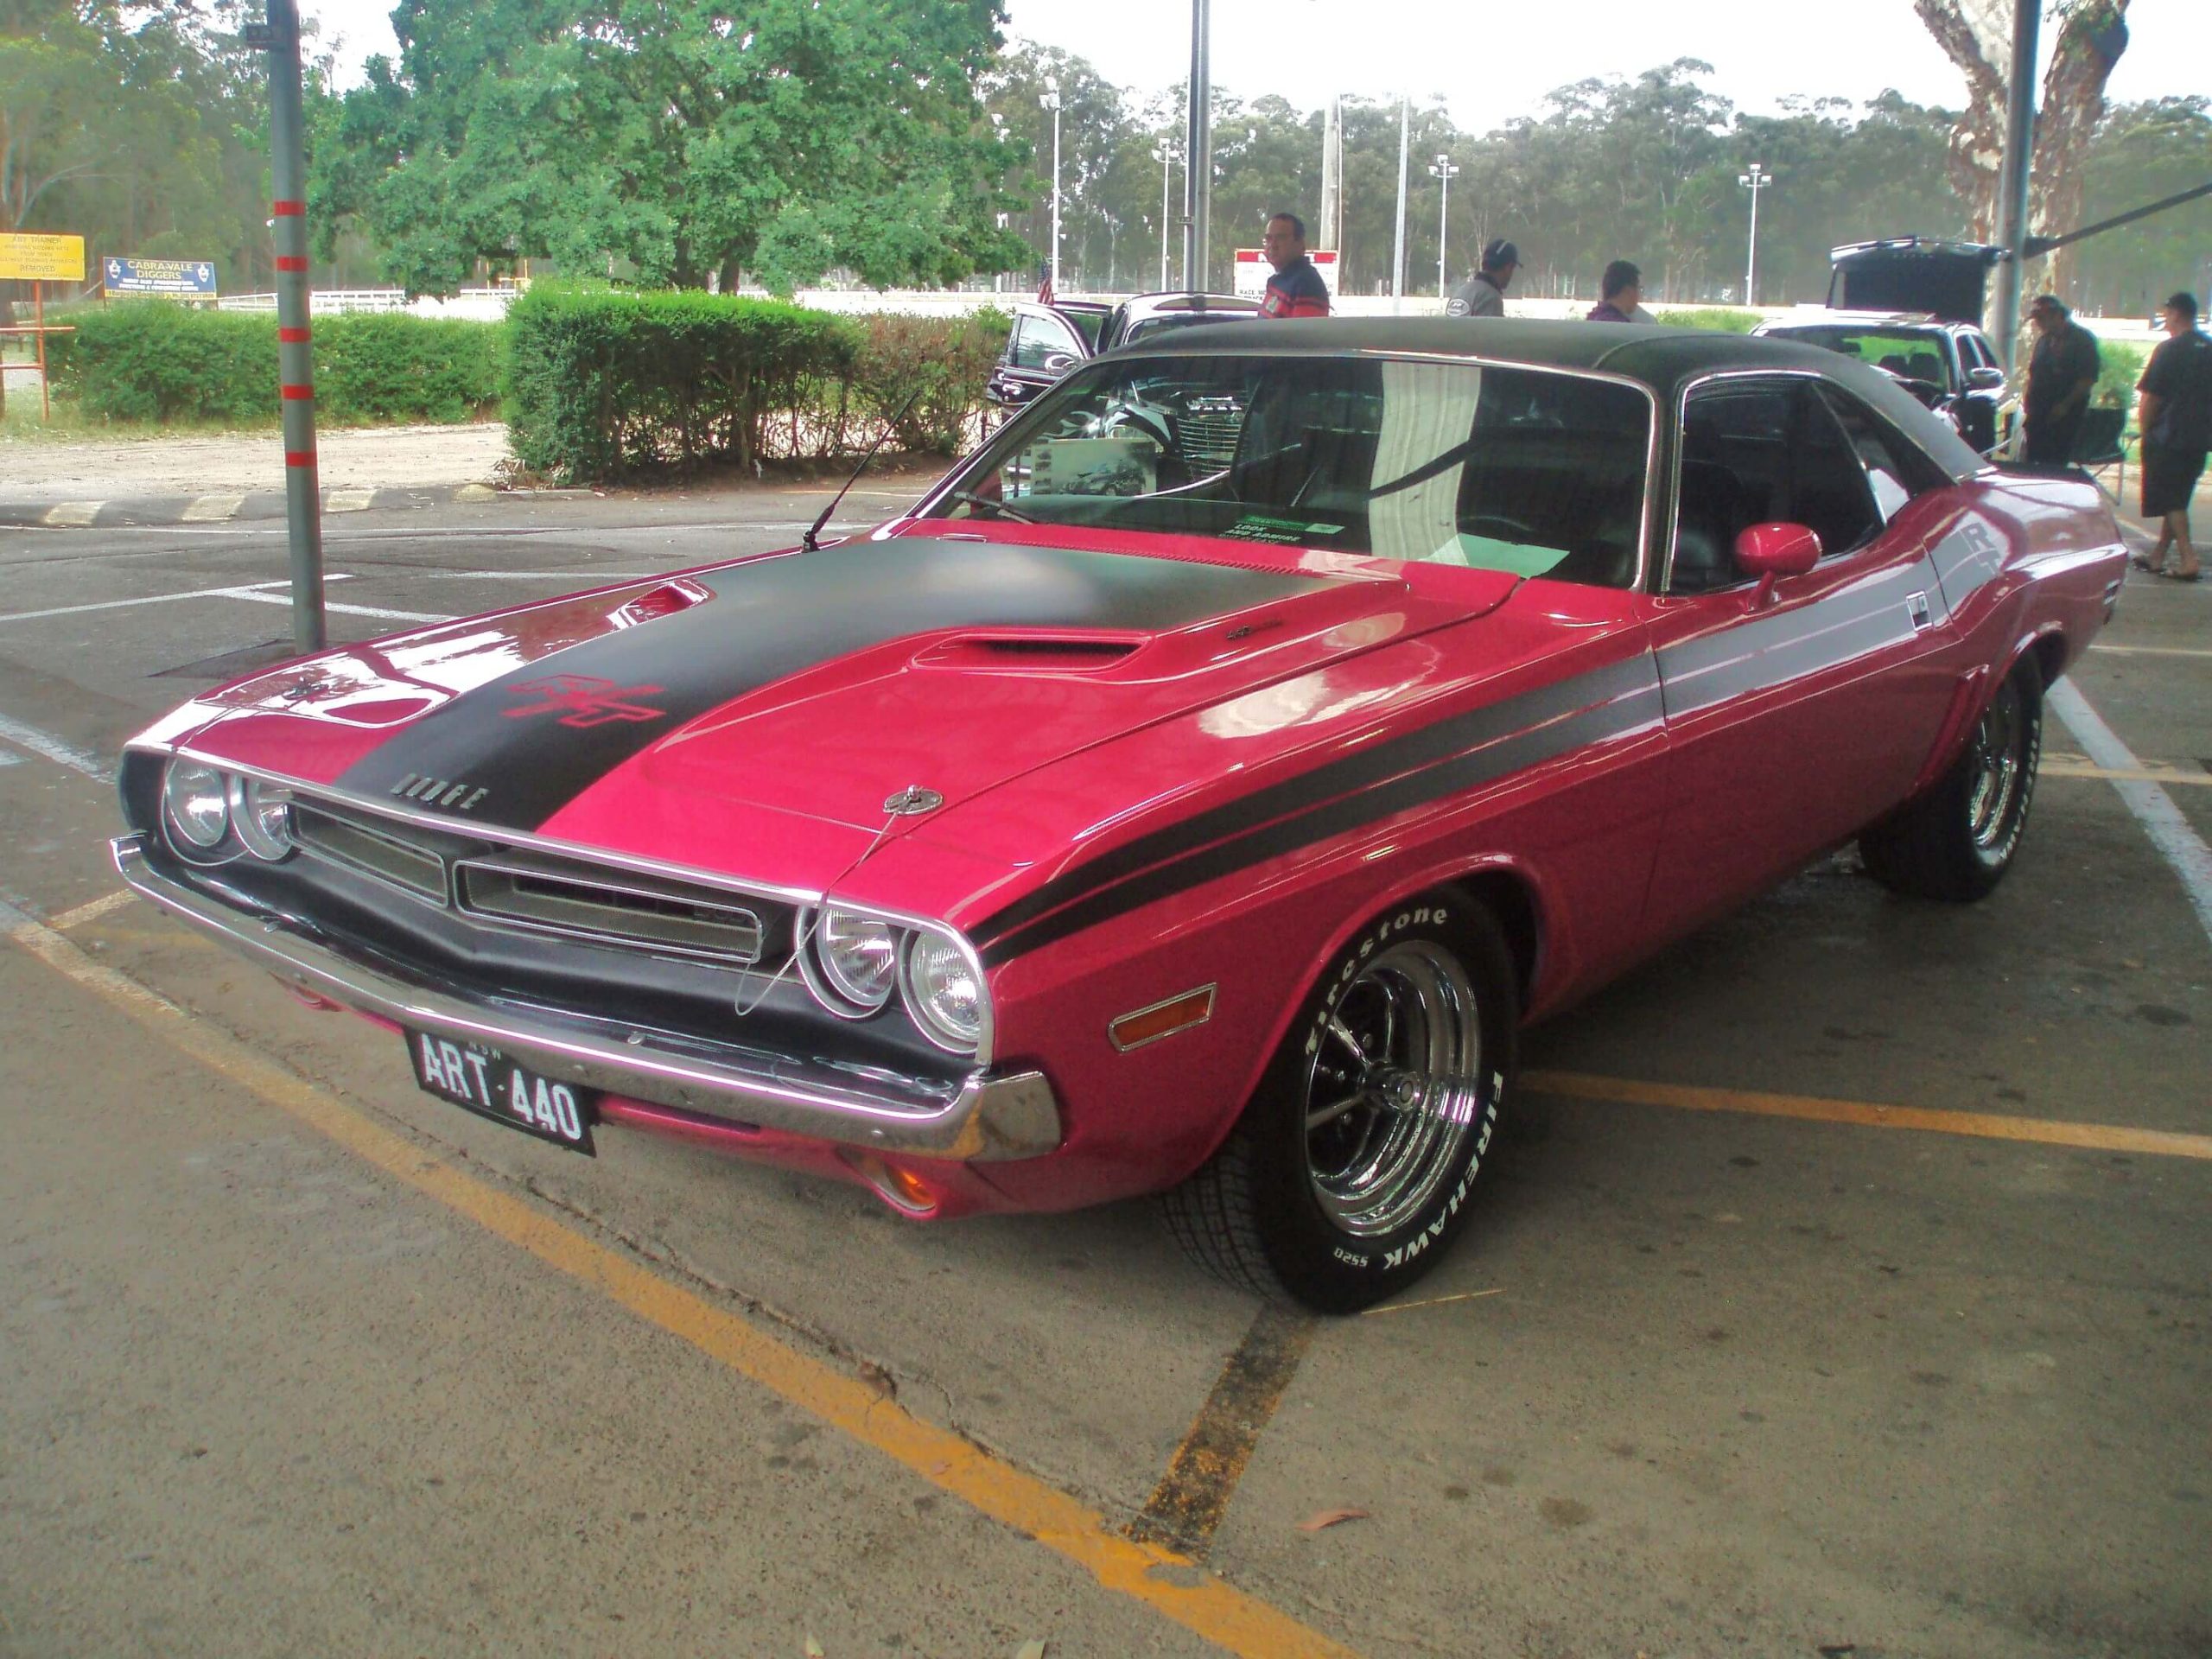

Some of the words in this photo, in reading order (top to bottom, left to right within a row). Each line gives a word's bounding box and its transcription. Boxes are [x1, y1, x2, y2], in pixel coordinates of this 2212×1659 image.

[137, 270, 181, 279] DIGGERS
[421, 1033, 492, 1107] ART
[512, 1069, 582, 1140] 440
[1383, 1071, 1504, 1269] FIREHAWK
